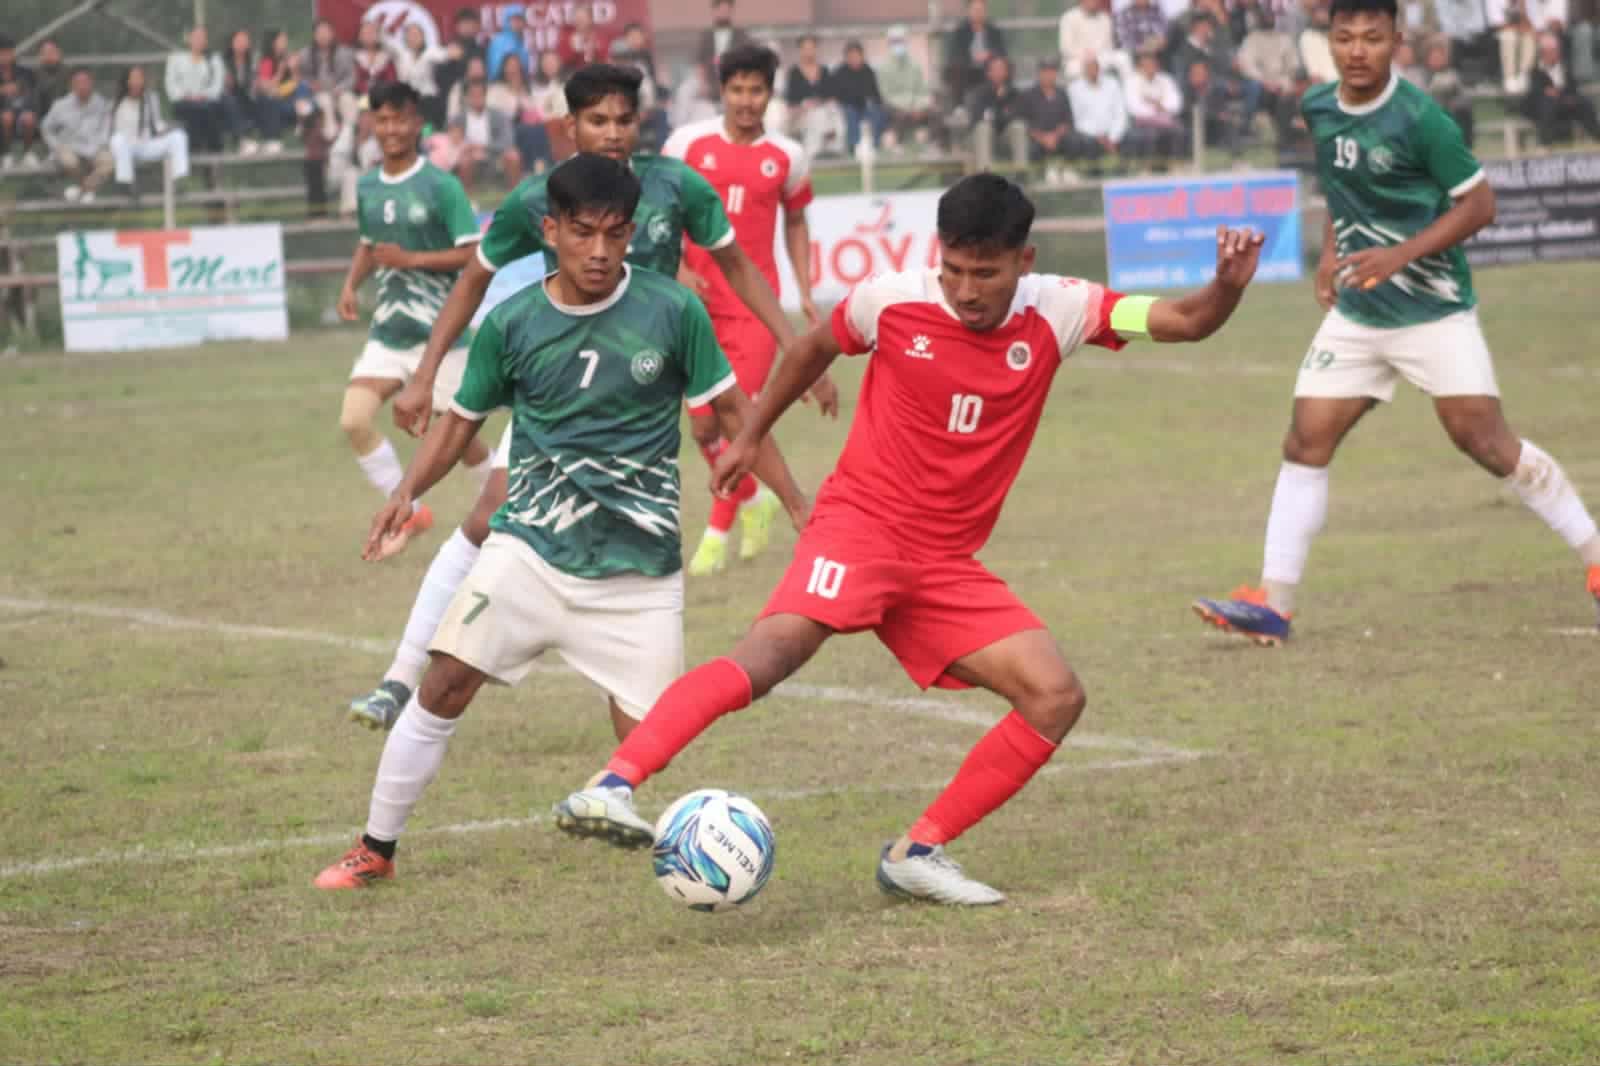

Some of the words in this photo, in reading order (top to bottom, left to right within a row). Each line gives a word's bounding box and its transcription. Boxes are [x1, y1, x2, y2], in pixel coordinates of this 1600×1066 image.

[1333, 136, 1359, 170] 19
[727, 184, 745, 214] 11
[114, 228, 192, 288] T
[170, 255, 278, 288] Mart
[579, 350, 600, 388] 7
[948, 393, 984, 433] 10
[806, 555, 847, 600] 10
[463, 591, 490, 625] 7
